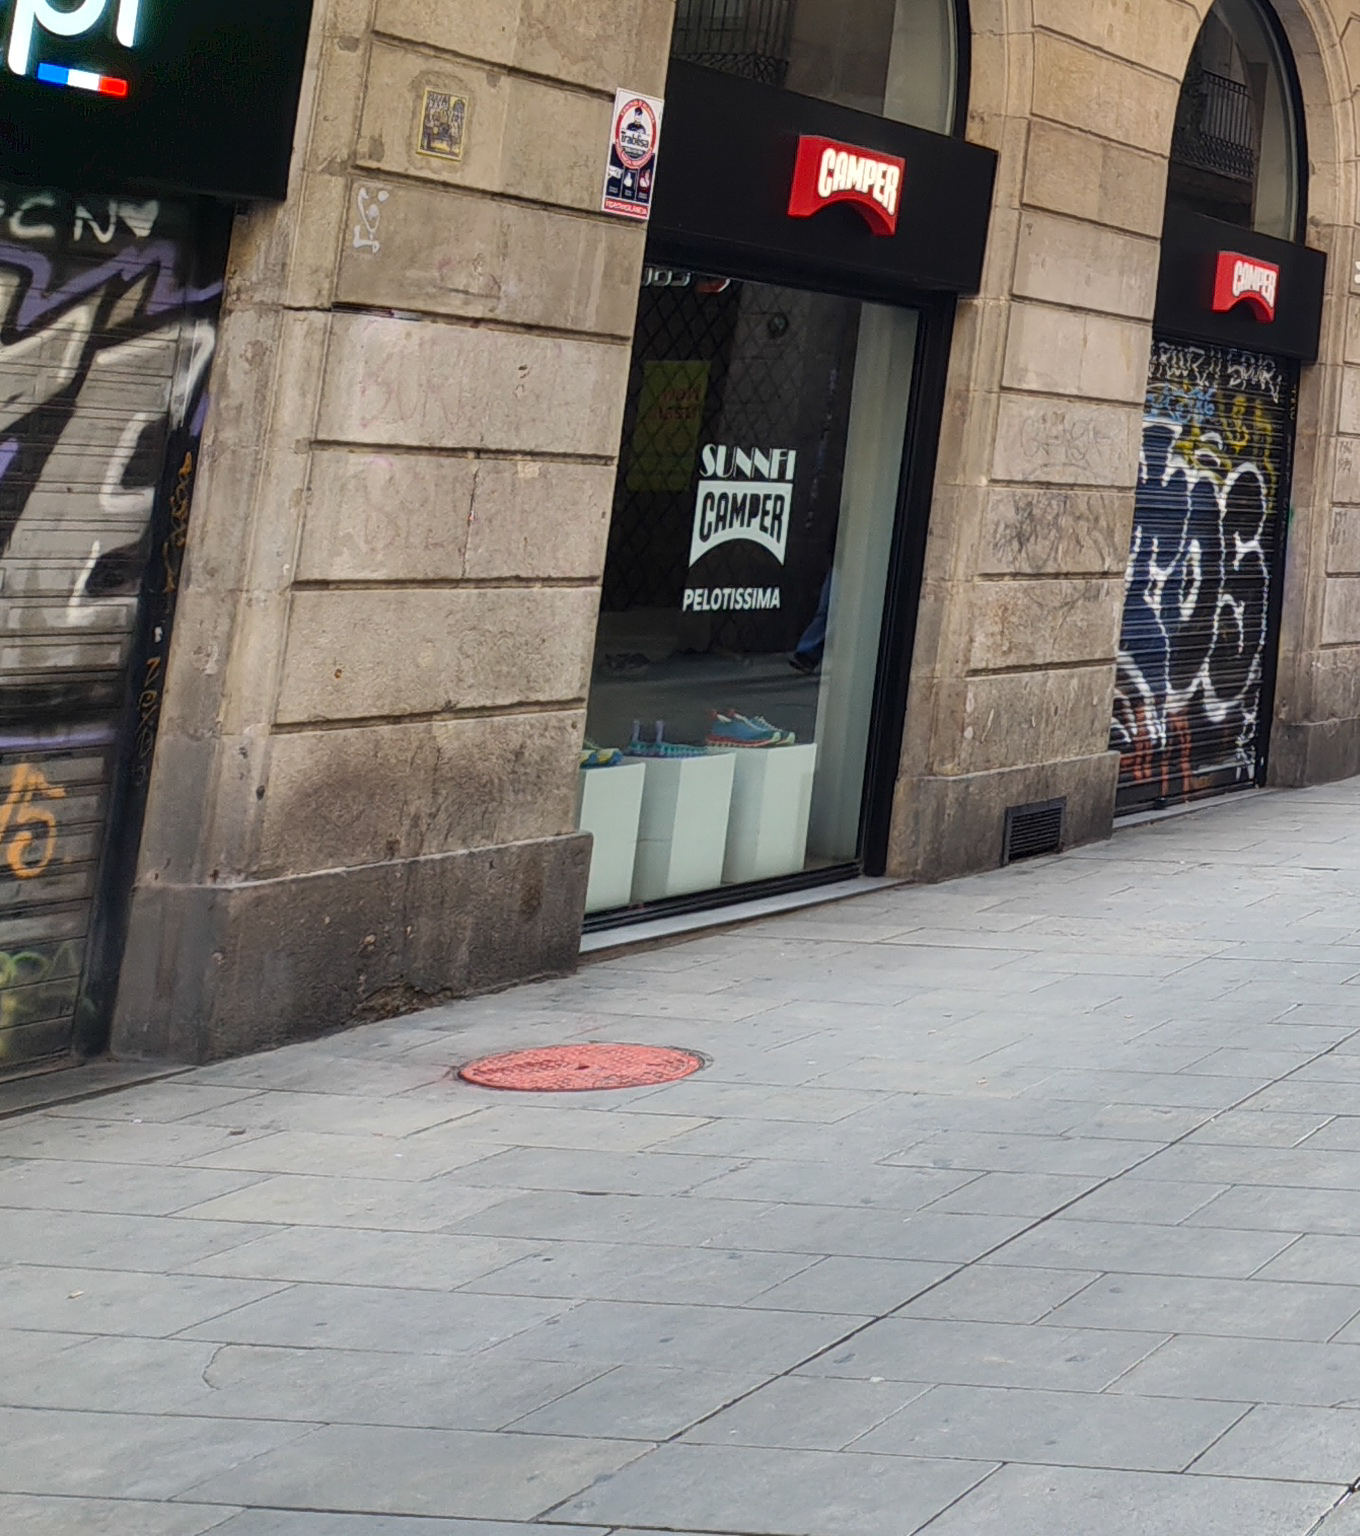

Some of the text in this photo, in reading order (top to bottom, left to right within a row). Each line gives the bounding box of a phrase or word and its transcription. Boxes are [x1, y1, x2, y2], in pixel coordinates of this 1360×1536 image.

[818, 148, 900, 215] CAMPER
[1232, 260, 1277, 308] CAMPER
[699, 491, 785, 544] CAMPER
[682, 587, 781, 612] PELOTISSIMA
